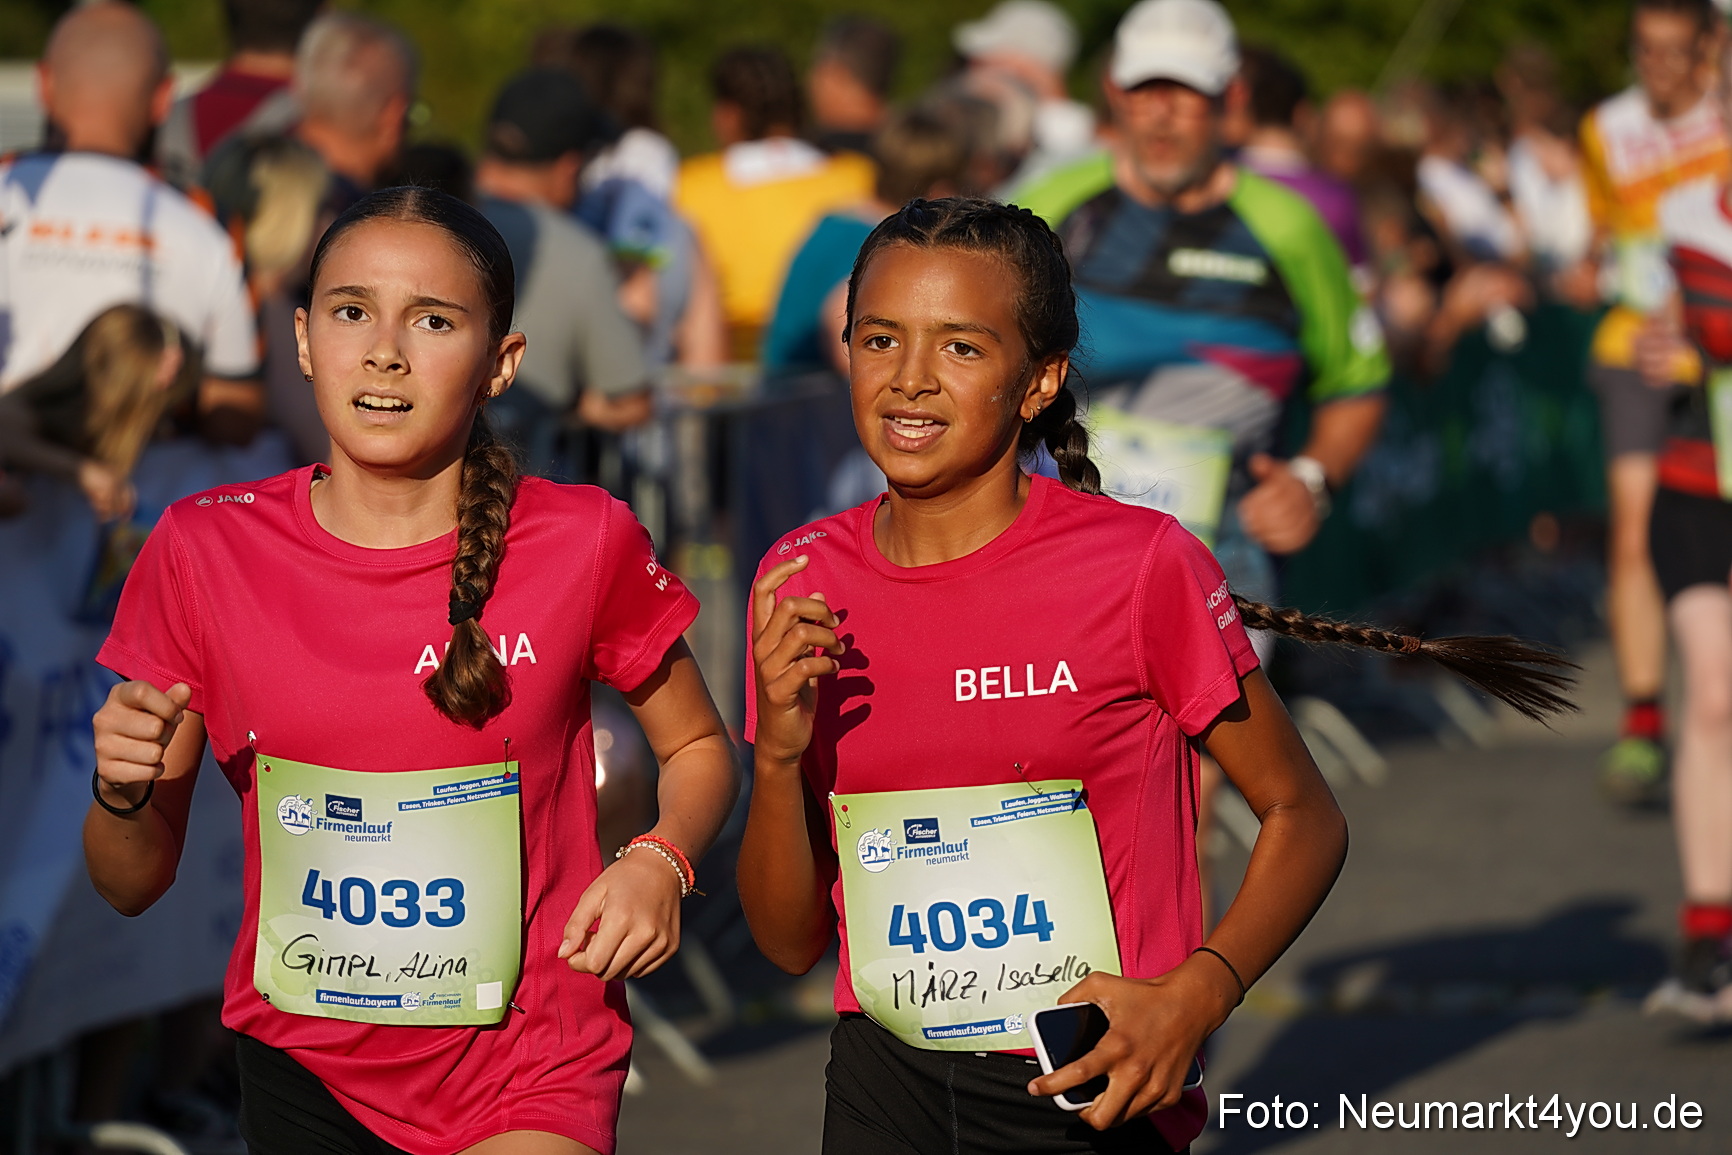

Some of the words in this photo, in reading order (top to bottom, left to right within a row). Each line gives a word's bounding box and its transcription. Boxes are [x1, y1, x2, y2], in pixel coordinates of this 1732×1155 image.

[217, 492, 255, 504] JAKO
[794, 531, 827, 547] JAKO
[413, 632, 537, 675] ANA
[955, 660, 1079, 702] BELLA
[436, 785, 458, 794] Laufen,
[459, 782, 481, 791] Joggen,
[481, 778, 504, 787] Walken
[401, 802, 422, 810] Essen,
[422, 799, 446, 808] Trinken,
[446, 796, 467, 805] Feiern,
[466, 790, 502, 801] Netzwerken
[1004, 799, 1027, 808] Laufen,
[333, 804, 360, 814] Fischer
[316, 817, 393, 834] Firmenlauf
[344, 833, 392, 842] neumarkt
[896, 838, 969, 860] Firmenlauf
[926, 852, 970, 866] neumarkt
[302, 868, 466, 928] 4033
[888, 893, 1055, 954] 4034
[997, 955, 1091, 991] Isabella
[319, 992, 397, 1008] firmenlauf.bayern
[421, 997, 462, 1006] Firmenlauf
[926, 1023, 1002, 1038] firmenlauf.bayern
